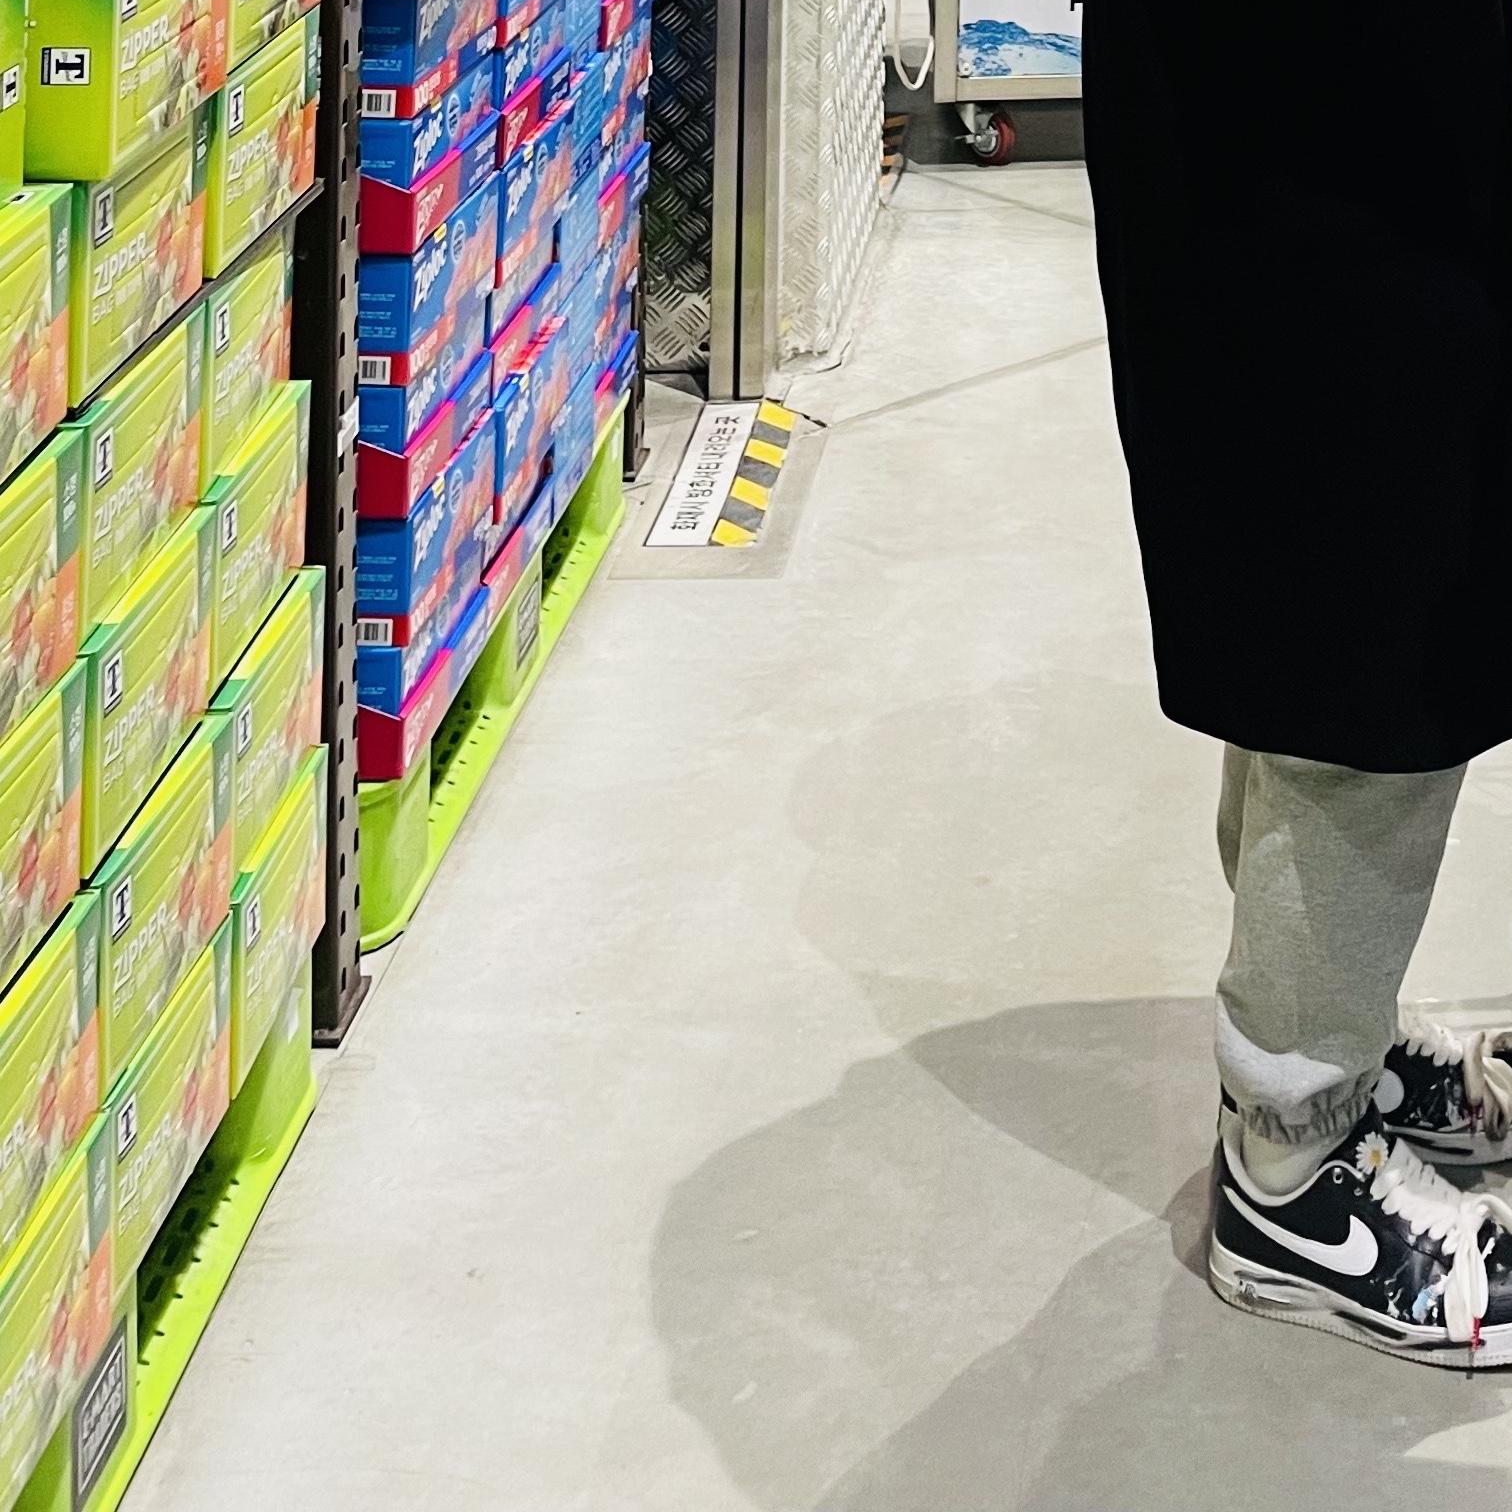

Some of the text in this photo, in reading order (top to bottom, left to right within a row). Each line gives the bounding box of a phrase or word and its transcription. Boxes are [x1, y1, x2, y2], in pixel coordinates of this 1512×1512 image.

[121, 17, 170, 72] ZIPPER
[228, 129, 270, 182] ZIPPER
[93, 232, 147, 300] ZIPPER
